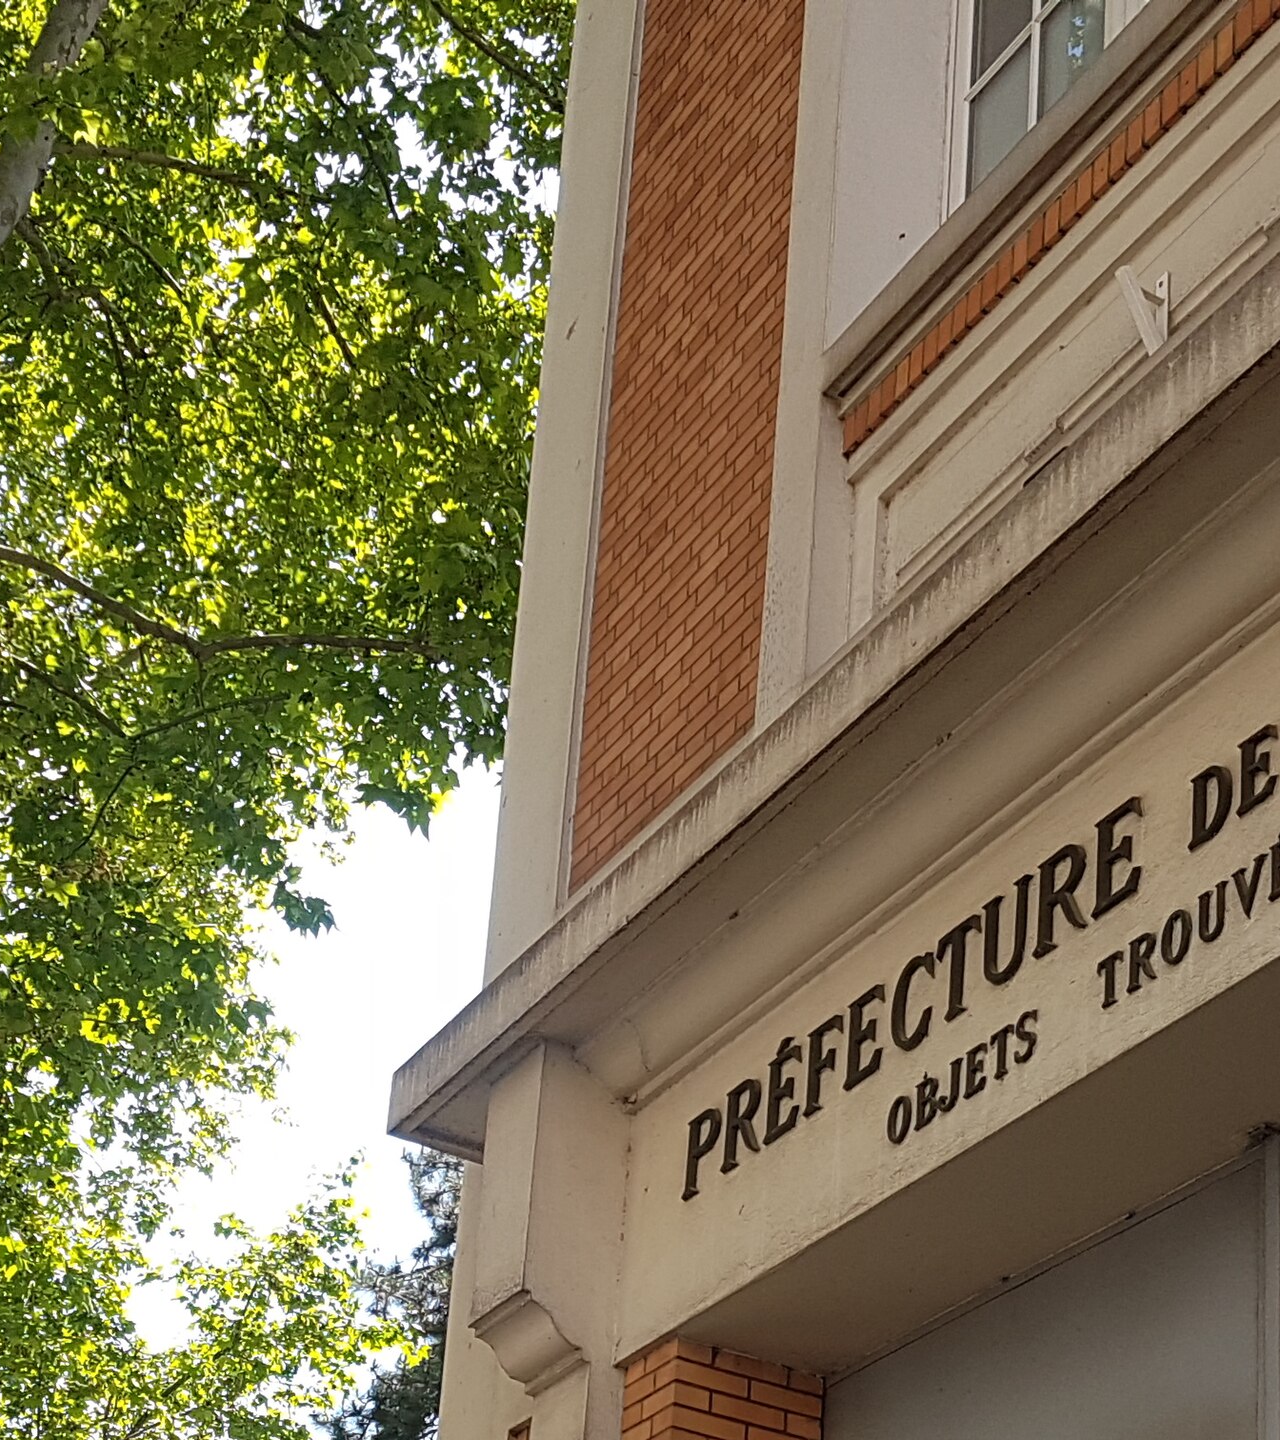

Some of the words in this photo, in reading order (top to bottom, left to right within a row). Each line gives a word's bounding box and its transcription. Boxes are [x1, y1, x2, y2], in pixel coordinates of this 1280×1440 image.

[679, 797, 1144, 1202] PRÉFECTURE
[1187, 724, 1280, 849] DE
[886, 1009, 1039, 1145] OBJETS
